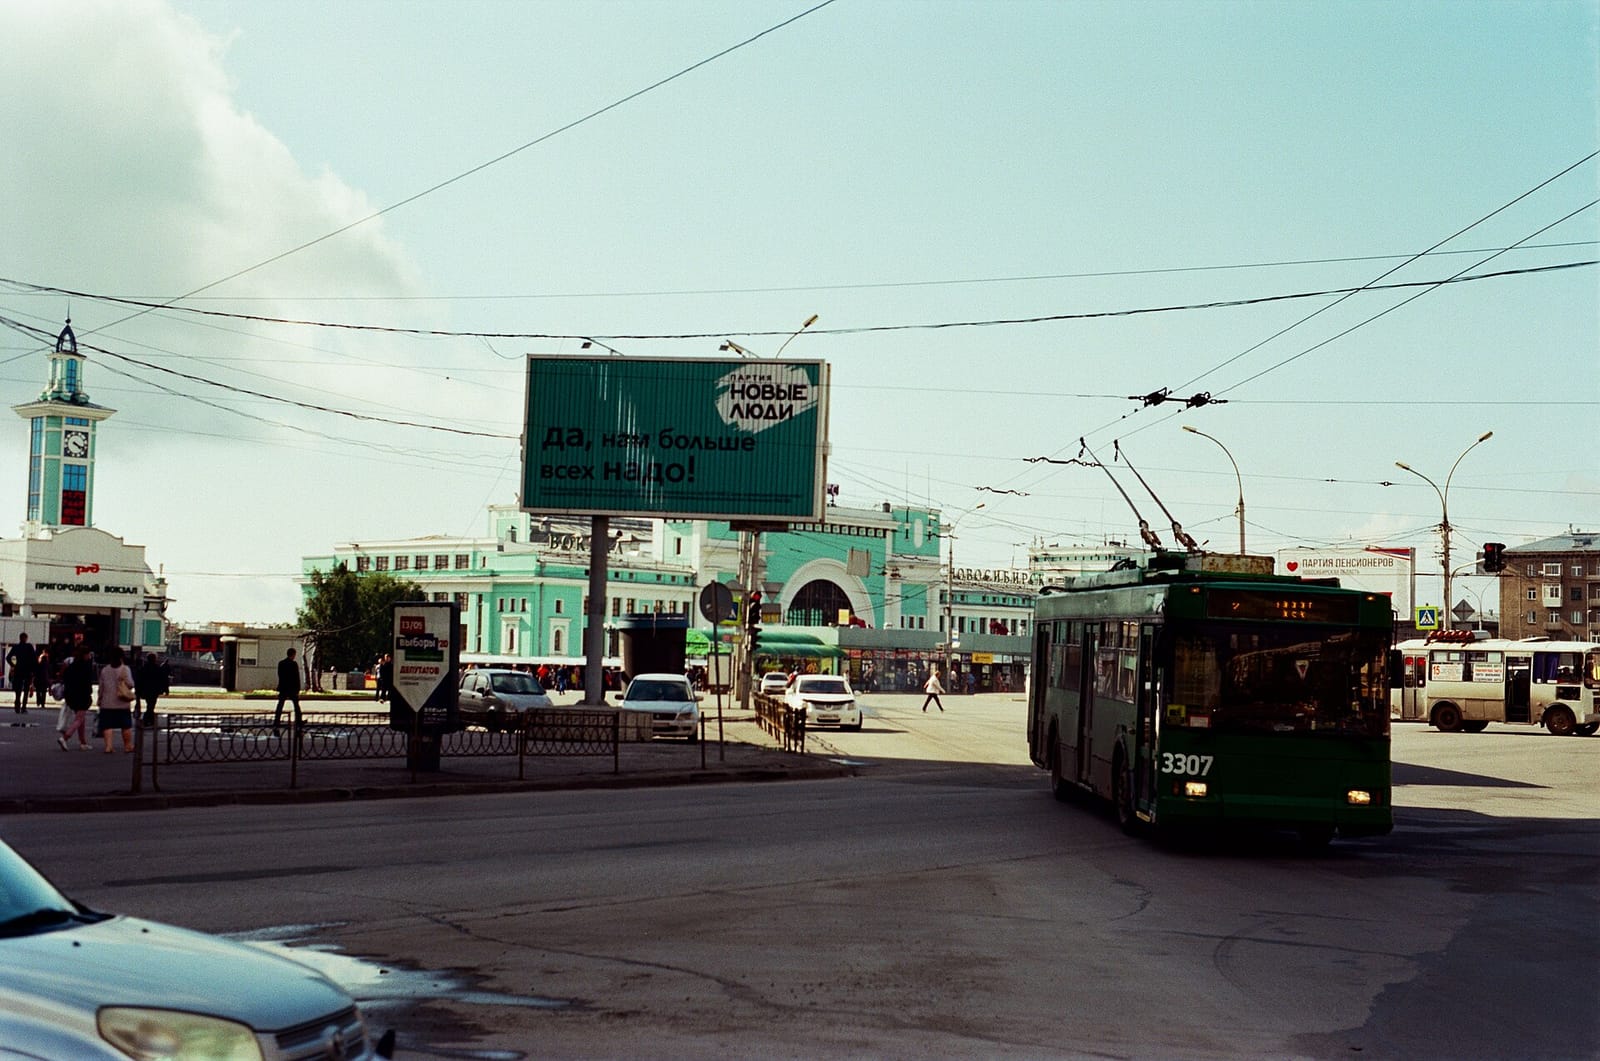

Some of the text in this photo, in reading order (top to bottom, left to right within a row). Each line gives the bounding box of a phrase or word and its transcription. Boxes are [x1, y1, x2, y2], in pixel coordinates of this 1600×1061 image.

[730, 383, 808, 401] НОВЫЕ
[729, 402, 794, 420] ЛЮДИ
[542, 427, 756, 452] да, нам больше
[540, 455, 696, 485] всех надо!
[1302, 558, 1394, 569] ПАРТИЯ ПЕНСИОНЕРОВ
[35, 582, 138, 594] ПРИГОРОДНЫЙ ВОКЗАЛ
[1161, 752, 1214, 776] 3307
